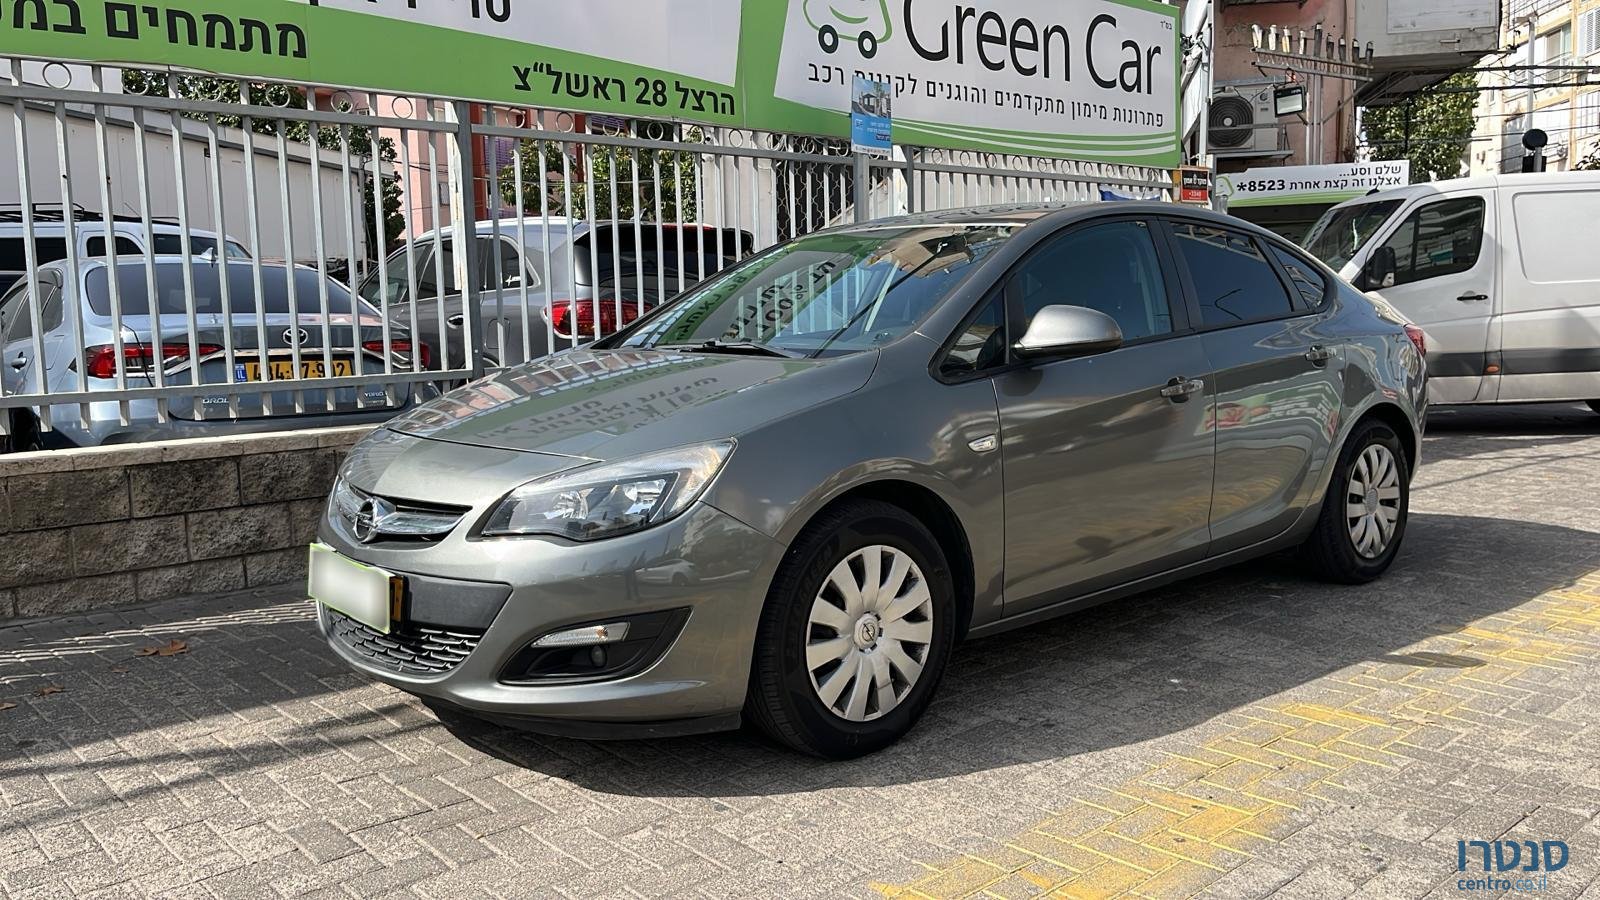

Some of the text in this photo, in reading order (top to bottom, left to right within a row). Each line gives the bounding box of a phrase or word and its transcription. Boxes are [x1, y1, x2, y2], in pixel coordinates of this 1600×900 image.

[0, 0, 86, 34] במ
[104, 2, 307, 59] מתמחים
[903, 0, 1161, 95] Green Car
[808, 63, 845, 85] רכב
[634, 77, 668, 107] 28
[674, 80, 736, 116] הרצל
[926, 80, 987, 104] והוגנים
[994, 90, 1065, 115] מתקדמים
[1071, 101, 1107, 120] מימון
[1112, 106, 1164, 127] פתרונות
[1375, 164, 1402, 175] שלם
[1289, 180, 1320, 190] אחרת
[1324, 179, 1348, 189] קצת
[1352, 178, 1364, 187] זה
